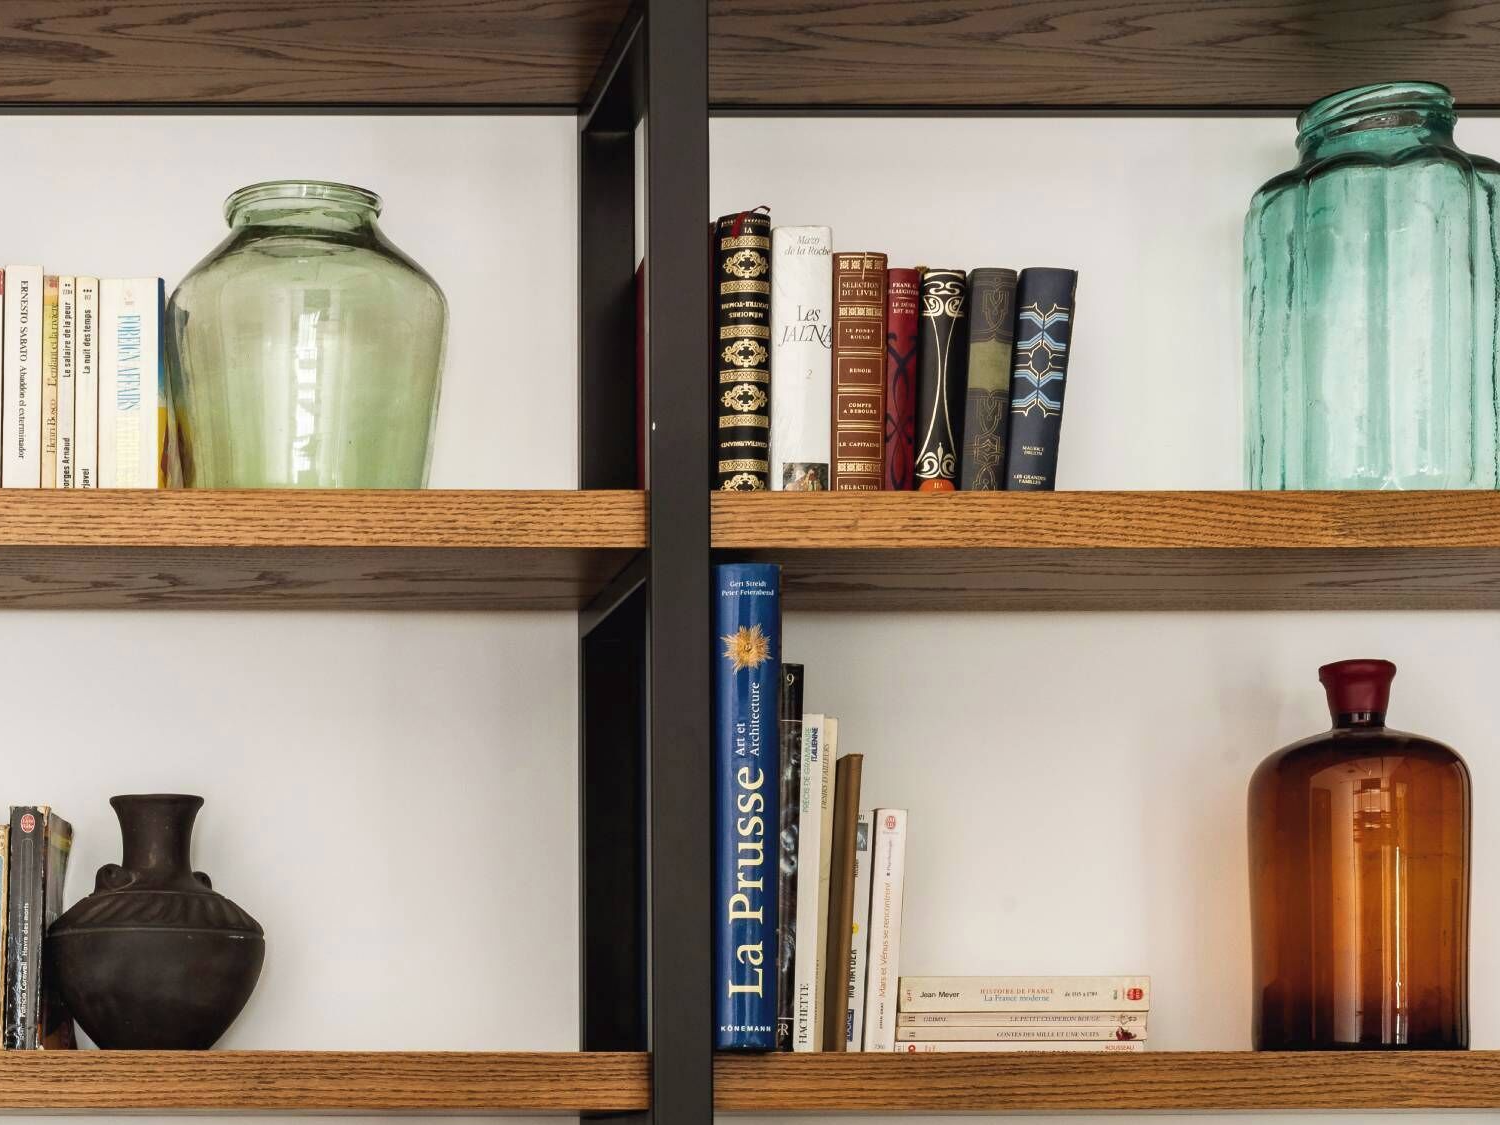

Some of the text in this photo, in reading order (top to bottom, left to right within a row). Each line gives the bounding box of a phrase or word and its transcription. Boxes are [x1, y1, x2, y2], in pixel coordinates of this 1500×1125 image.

[20, 280, 28, 324] ERNESTO
[20, 327, 28, 362] SABATO
[63, 302, 72, 377] Le salaire de la peur
[117, 315, 140, 411] FOREIGN AFFAIRS
[18, 408, 27, 458] exterminador
[735, 723, 745, 756] Art et
[749, 682, 760, 756] Architecture
[810, 728, 819, 762] ITALIENNE
[727, 767, 765, 998] La Prusse
[798, 984, 809, 1043] HACHETTE
